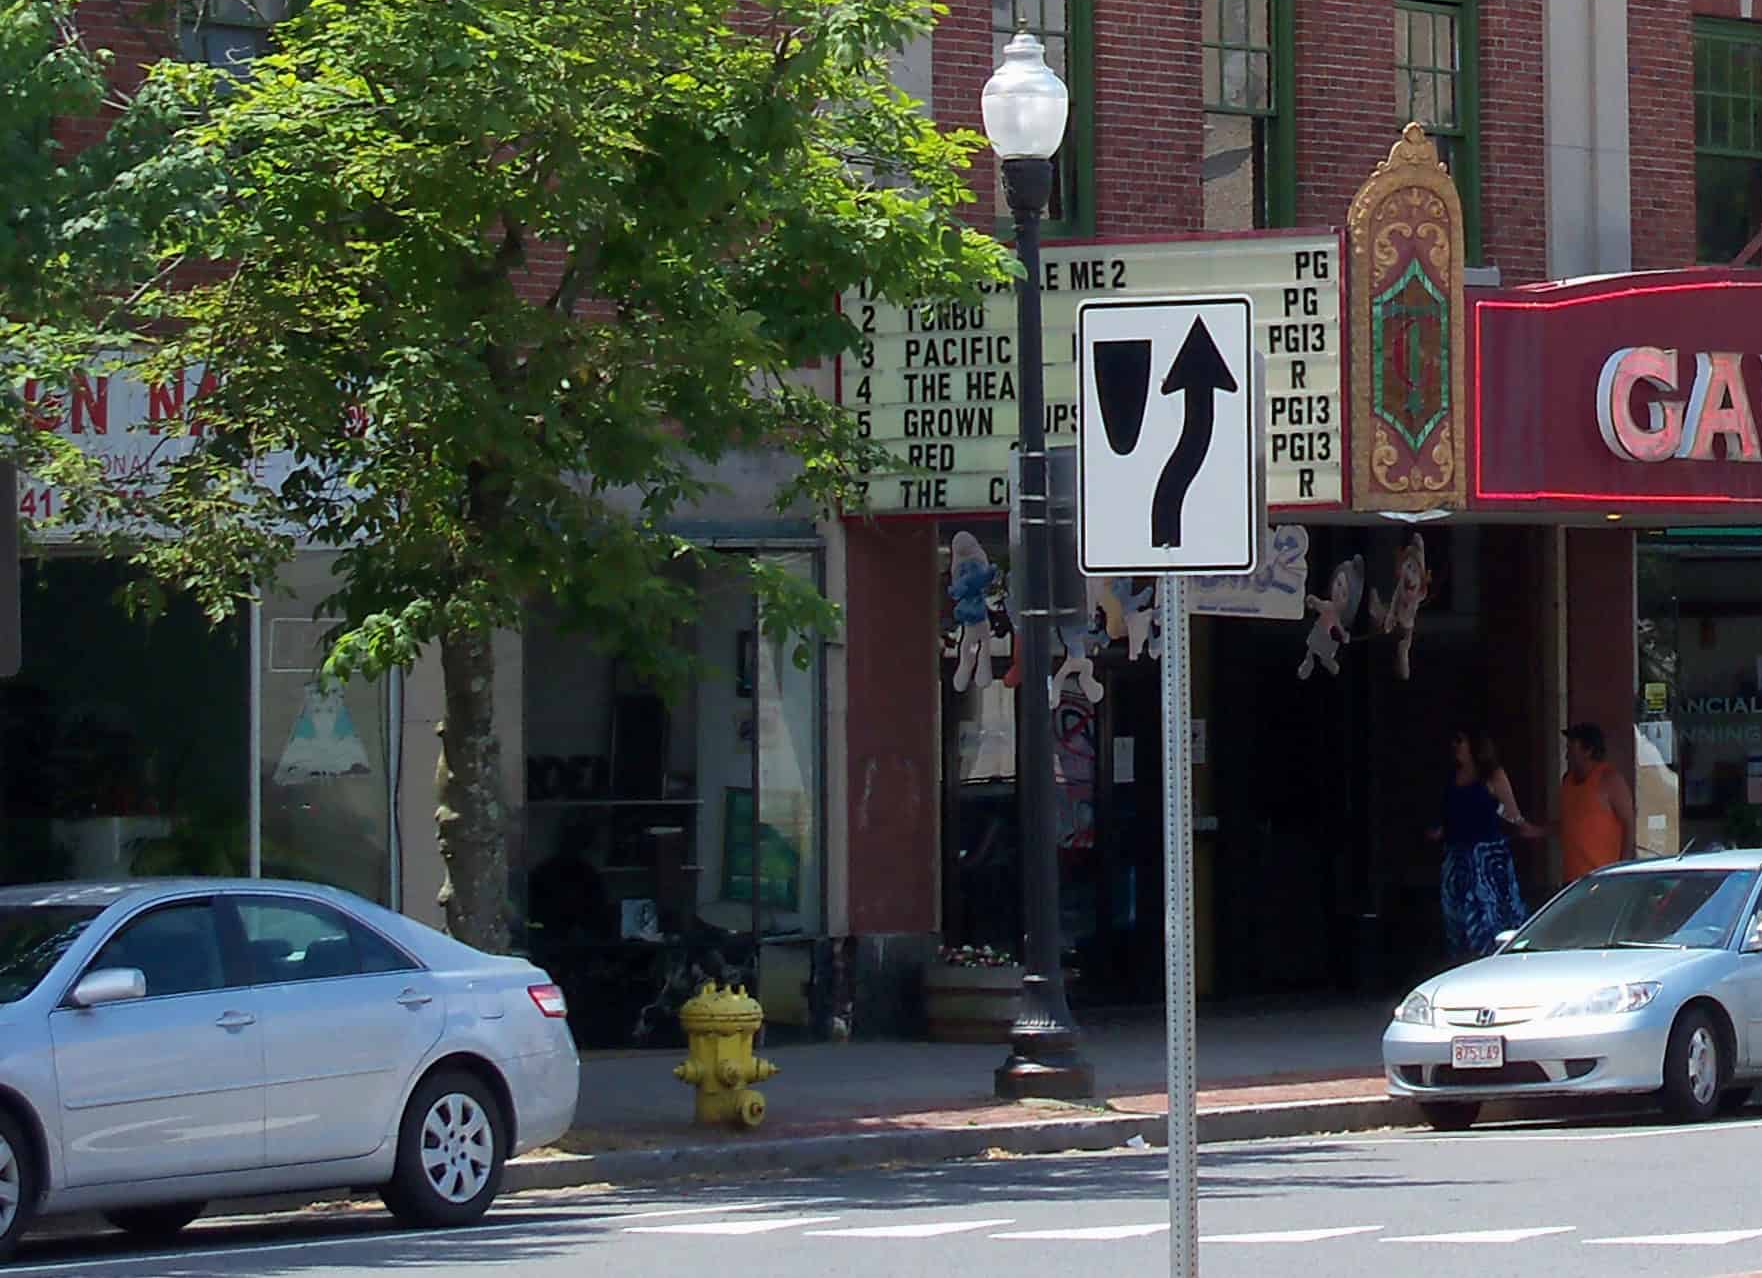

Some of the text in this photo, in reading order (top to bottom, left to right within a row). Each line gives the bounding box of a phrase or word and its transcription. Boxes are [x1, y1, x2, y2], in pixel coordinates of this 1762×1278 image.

[1071, 261, 1104, 290] ME
[1111, 260, 1125, 288] 2
[1295, 251, 1328, 280] PG
[862, 306, 875, 333] 2
[1284, 287, 1318, 317] PG
[861, 323, 1325, 369] 3 PACIFIC PG13
[856, 360, 1306, 404] 4 THE HEA R
[857, 410, 871, 438] 5
[904, 407, 993, 438] GROWN
[1270, 395, 1330, 426] PG13
[909, 432, 1331, 471] RED PG13
[901, 478, 947, 508] THE
[1299, 469, 1314, 498] R
